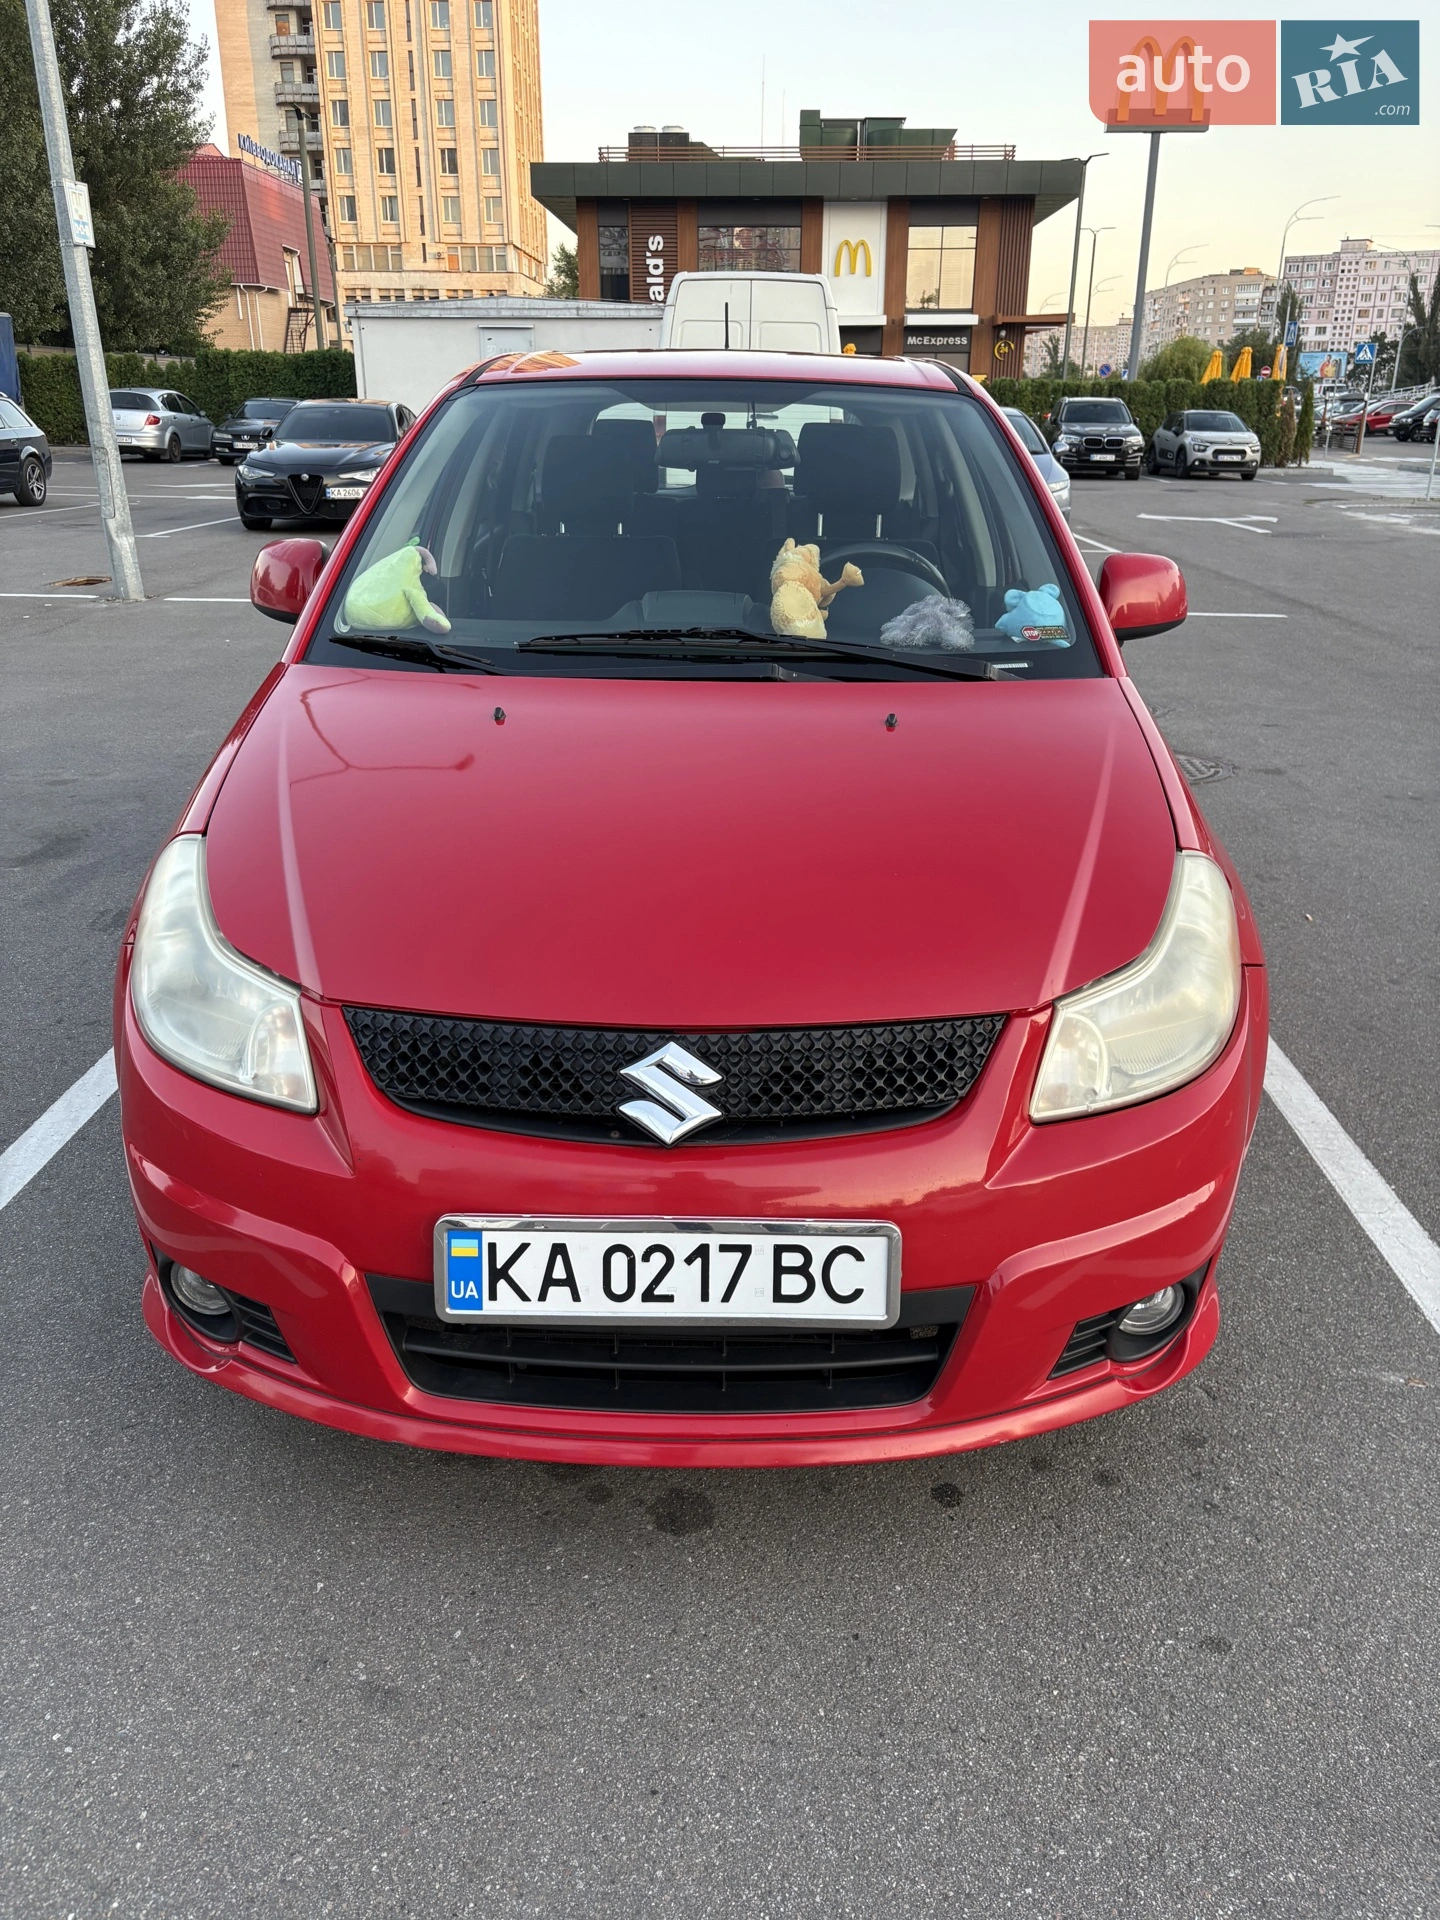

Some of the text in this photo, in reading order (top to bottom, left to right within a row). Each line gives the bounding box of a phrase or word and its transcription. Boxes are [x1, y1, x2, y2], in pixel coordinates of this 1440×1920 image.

[646, 235, 665, 305] ald's
[906, 336, 968, 346] McExpress
[330, 489, 342, 497] KA
[343, 489, 361, 497] 2606
[487, 1241, 866, 1304] KA 0217 BC
[451, 1280, 479, 1299] UA
